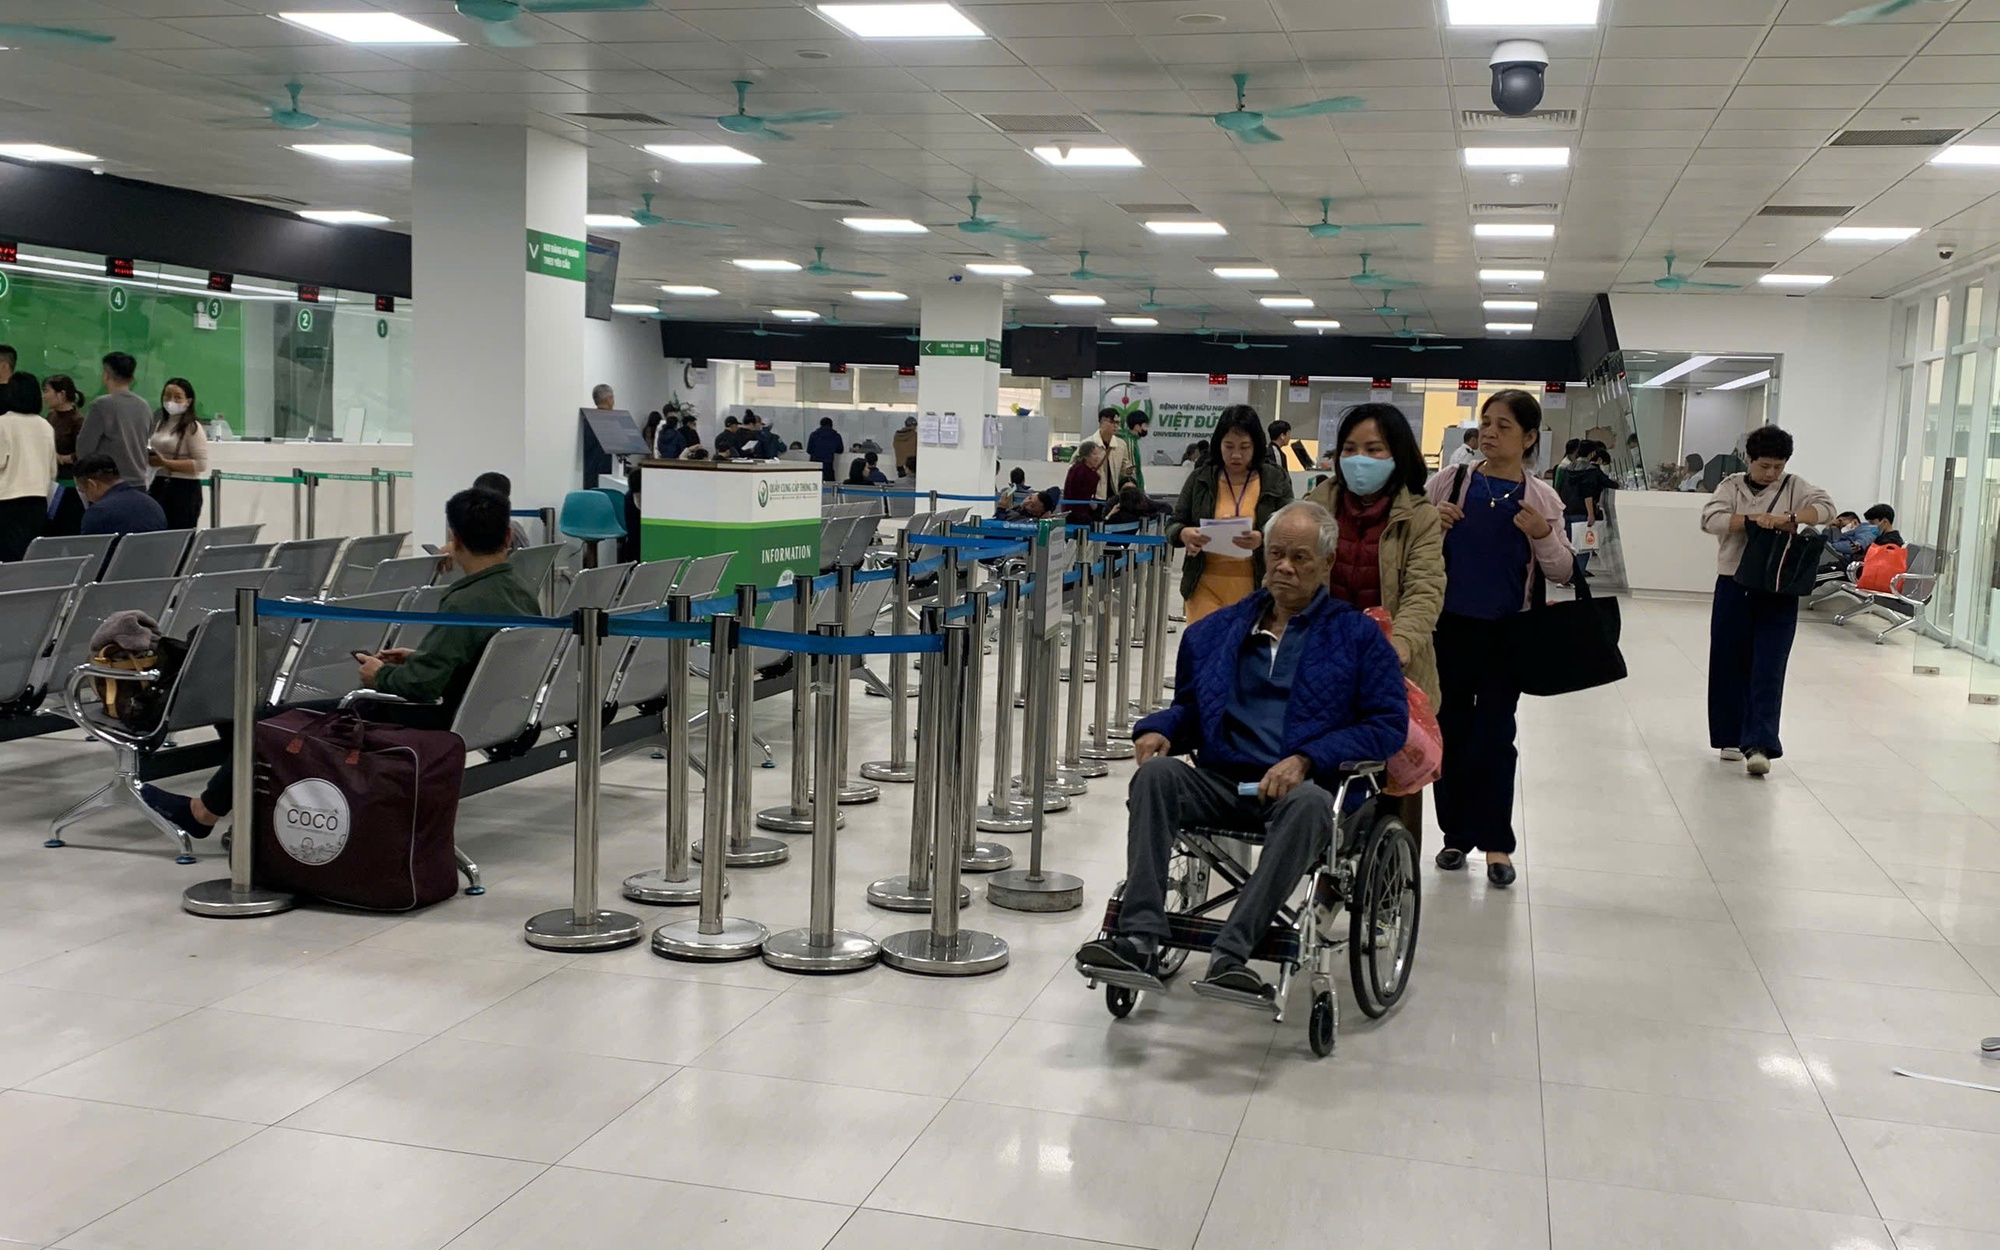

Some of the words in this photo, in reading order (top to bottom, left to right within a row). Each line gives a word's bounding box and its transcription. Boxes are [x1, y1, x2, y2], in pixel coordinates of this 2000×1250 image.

[114, 291, 122, 306] 4
[212, 302, 218, 316] 3
[302, 313, 309, 327] 2
[1159, 402, 1178, 411] BỆNH
[1179, 402, 1196, 411] VIỆN
[1158, 411, 1193, 431] VIỆT
[1194, 412, 1220, 429] ĐỨ
[1152, 430, 1192, 438] UNIVERSITY
[761, 544, 812, 564] INFORMATION
[287, 808, 339, 831] COCO
